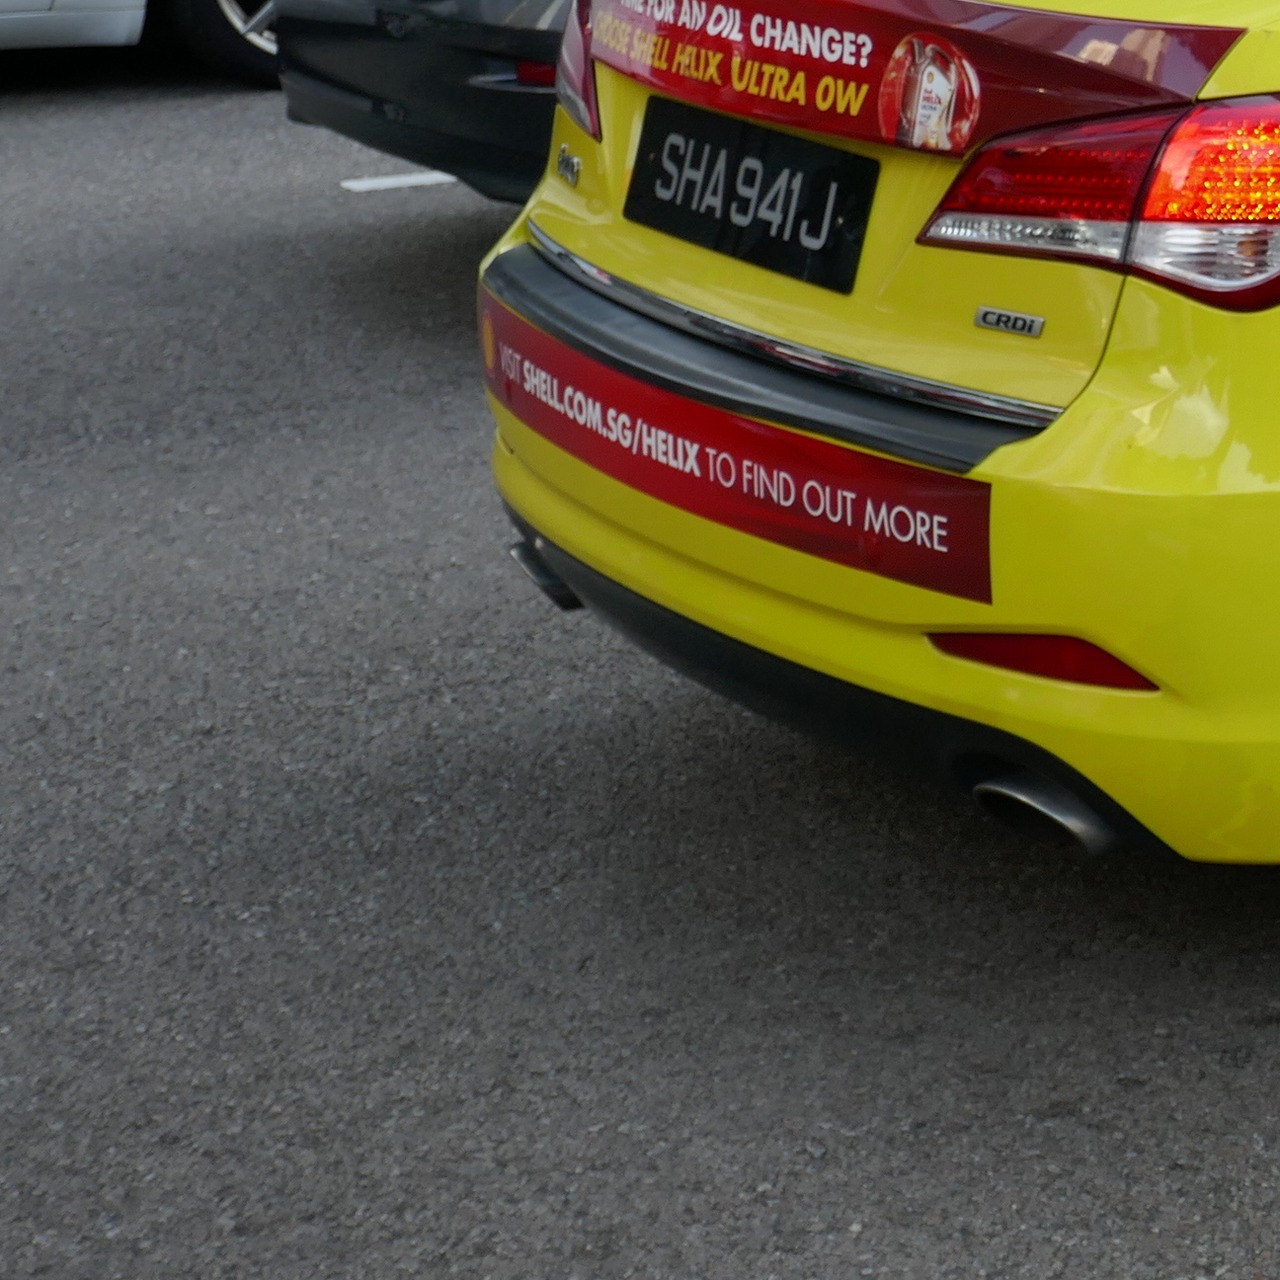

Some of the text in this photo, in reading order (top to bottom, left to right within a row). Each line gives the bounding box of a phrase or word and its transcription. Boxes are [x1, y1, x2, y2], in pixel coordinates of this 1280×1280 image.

[630, 27, 671, 71] SHELL
[671, 40, 725, 86] HELIX
[730, 54, 806, 107] ULTRA
[706, 3, 744, 42] OIL
[750, 12, 873, 69] CHANGE?
[982, 310, 1035, 333] CRDi
[499, 340, 949, 553] VISIT SHELL.COM.SG/HELIX TO FIND OUT MORE
